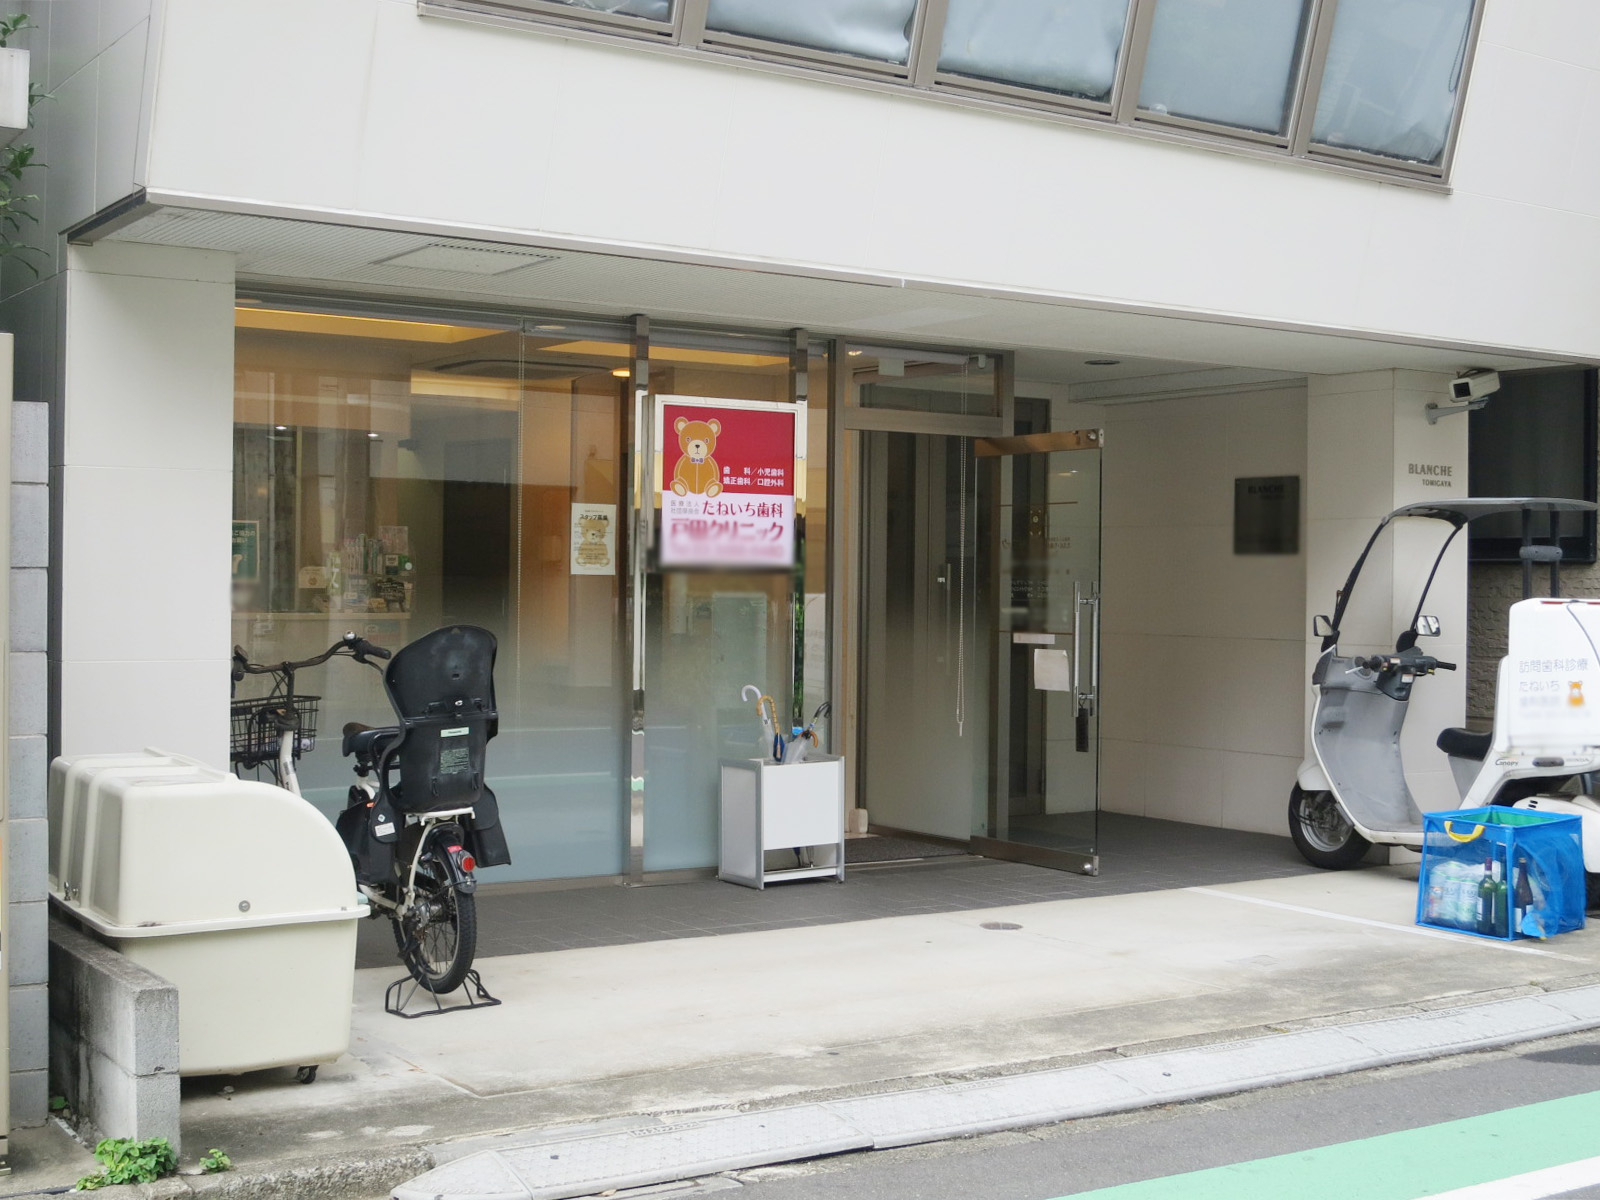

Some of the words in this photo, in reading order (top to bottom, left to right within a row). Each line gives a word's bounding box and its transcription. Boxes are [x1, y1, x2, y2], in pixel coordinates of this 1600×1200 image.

[1408, 463, 1453, 477] BLANCHE
[1422, 478, 1452, 488] TOMIGAYA
[702, 501, 783, 518] たねいち歯科
[1519, 658, 1589, 673] 訪問歯科診療
[1519, 680, 1560, 693] たねいち
